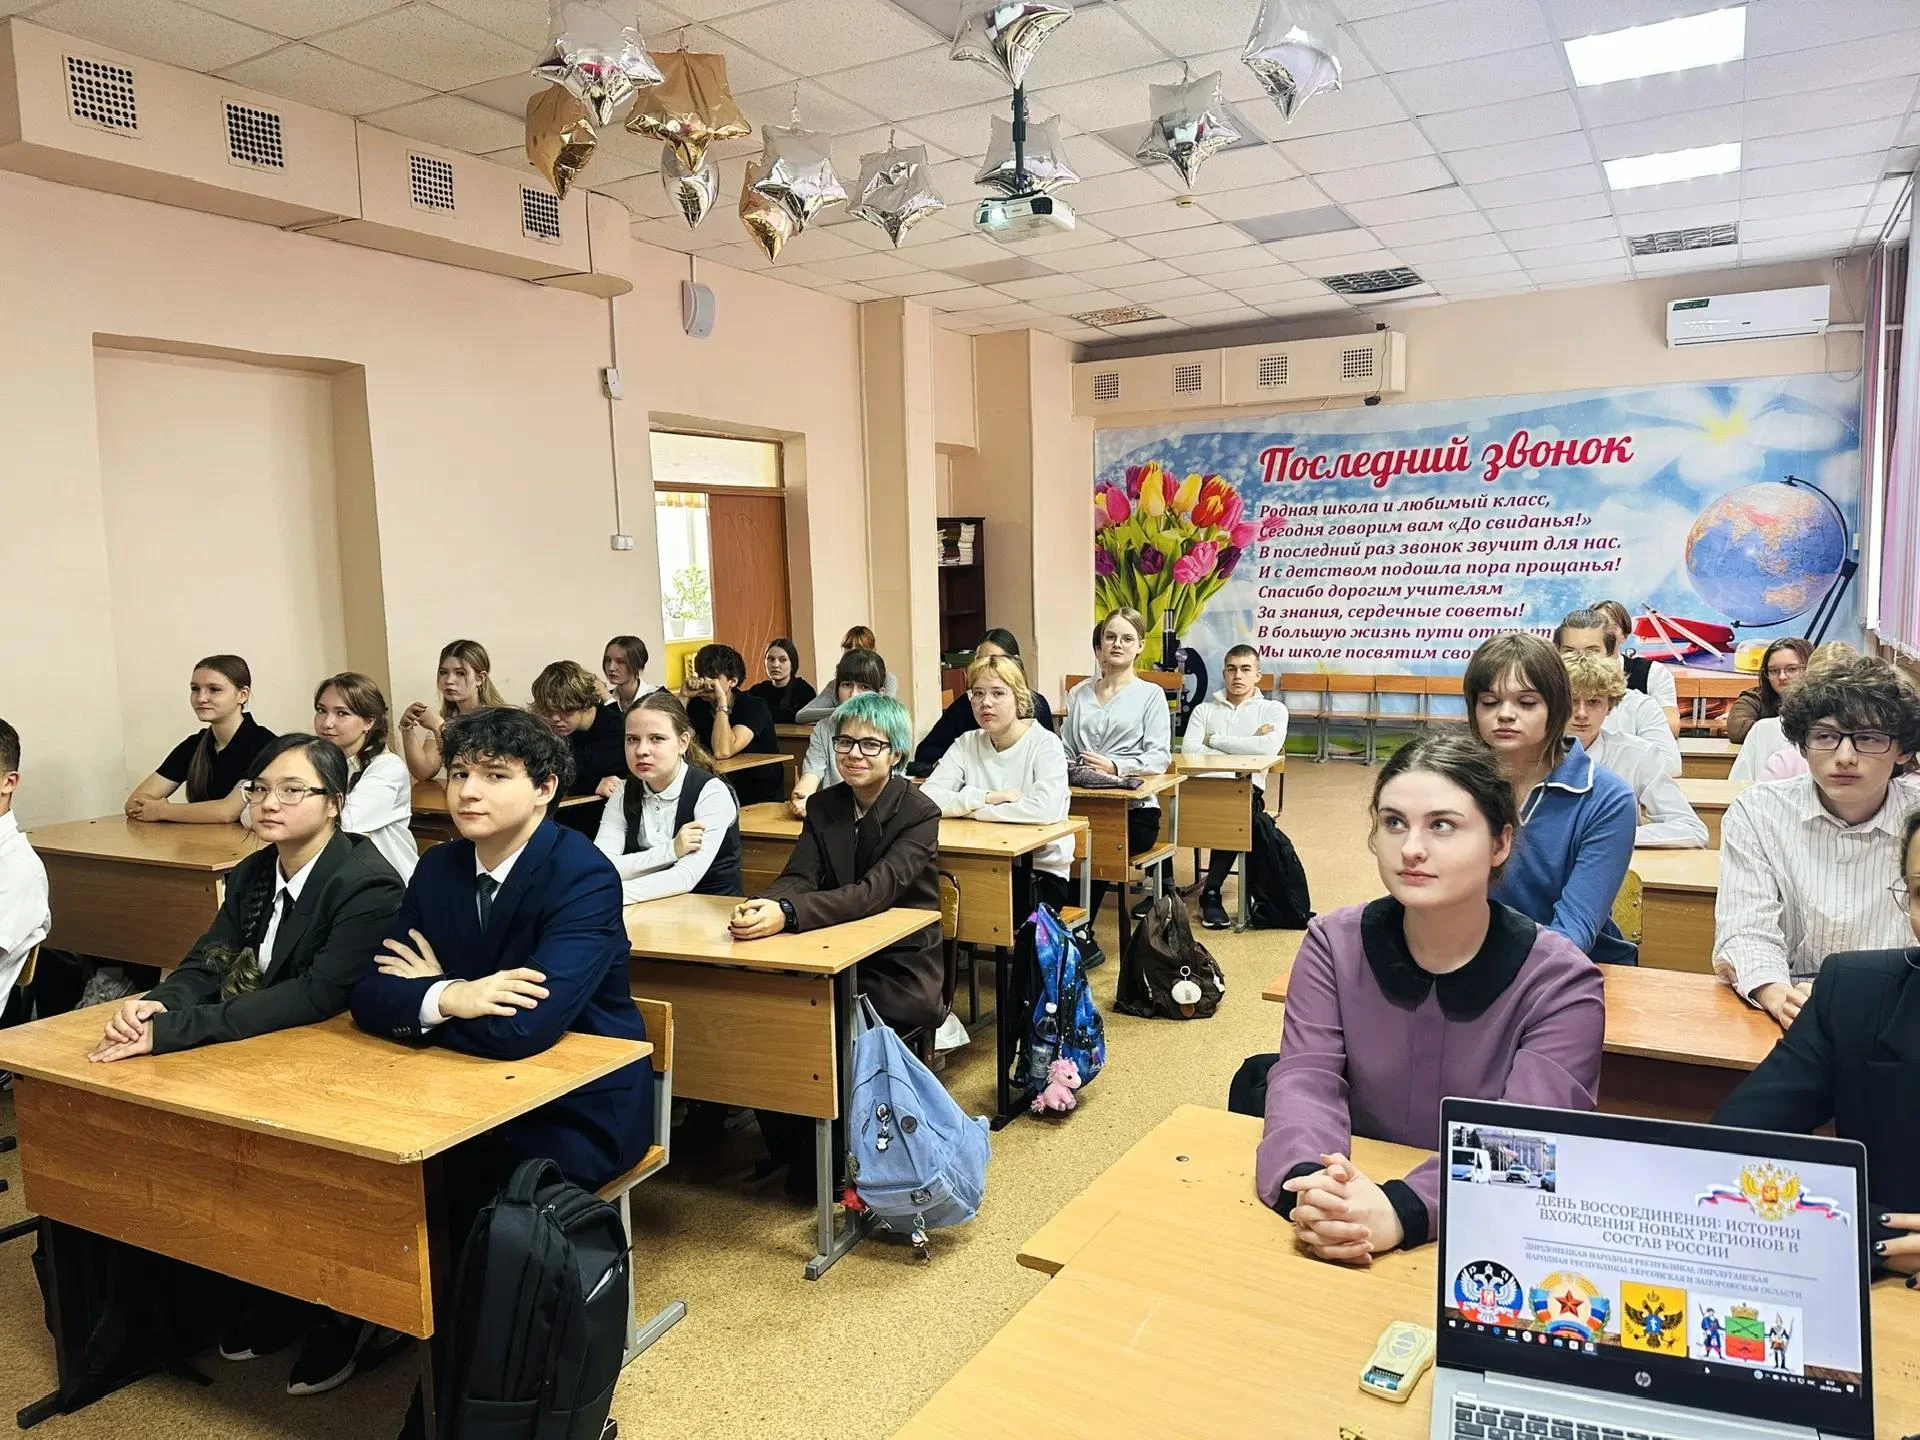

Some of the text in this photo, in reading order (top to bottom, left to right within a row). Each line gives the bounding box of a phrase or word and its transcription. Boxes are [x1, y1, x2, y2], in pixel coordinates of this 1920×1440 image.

[1259, 430, 1634, 488] Последний звонок
[1259, 494, 1550, 517] Родная школа и любимый класс,
[1259, 513, 1592, 538] Сегодня говорим вам «До свиданья!»
[1259, 536, 1622, 559] В последний раз звонок звучит для нас.
[1258, 558, 1622, 578] И с детством подошла пора прощанья!
[1258, 584, 1503, 600] Спасибо дорогим учителям
[1257, 603, 1525, 621] За знания, сердечные советы!
[1257, 626, 1268, 638] В
[1272, 626, 1346, 641] большую
[1350, 628, 1411, 639] жизнь
[1415, 628, 1463, 641] пути
[1259, 645, 1476, 660] Мы школе посвятим сво
[1536, 1194, 1800, 1239] ДЕНЬ ВОССОЕДИНЕНИЯ: ИСТОРИЯ
[1540, 1208, 1799, 1253] ВХОЖДЕНИЯ НОВЫХ РЕГИОНОВ В
[1602, 1231, 1729, 1259] СОСТАВ РОССИИ
[1634, 1371, 1651, 1388] hp
